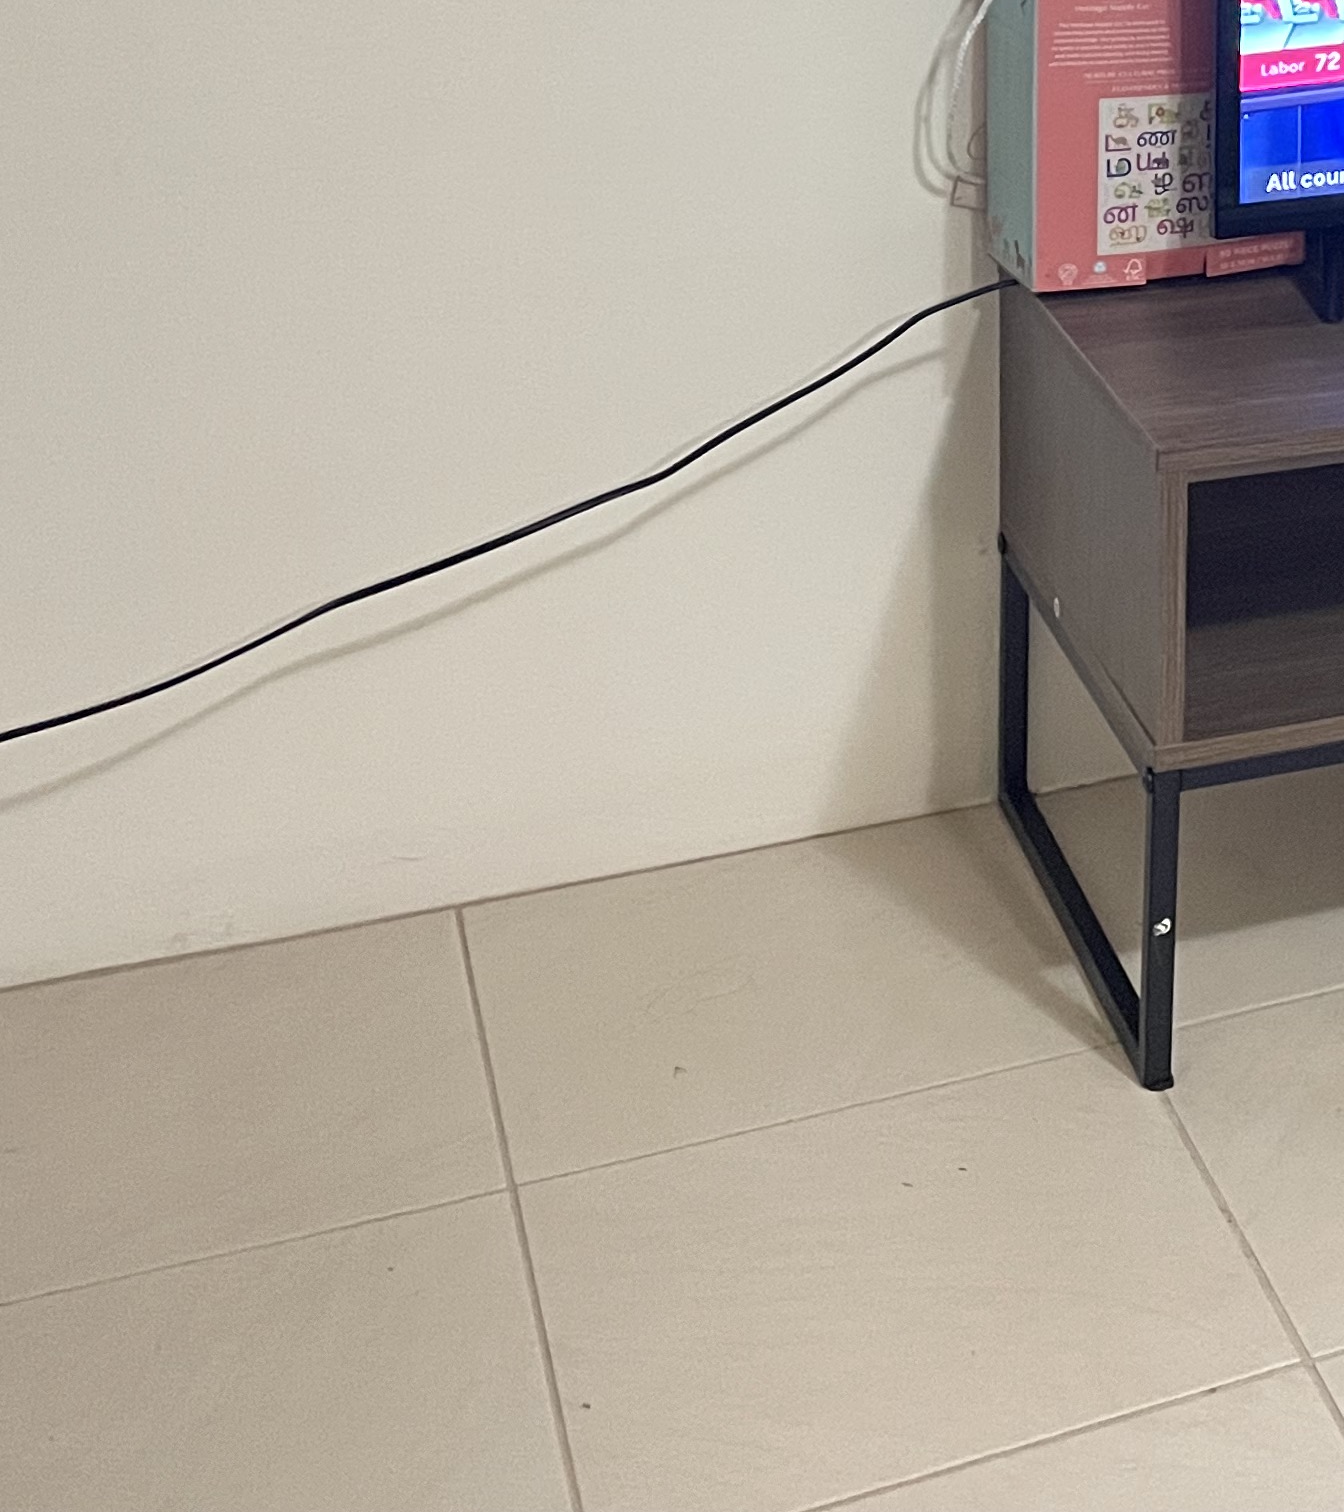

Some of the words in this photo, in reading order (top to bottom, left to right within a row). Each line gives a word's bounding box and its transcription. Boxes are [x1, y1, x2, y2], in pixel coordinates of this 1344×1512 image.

[1260, 61, 1305, 77] Labor
[1314, 51, 1341, 73] 72
[1266, 170, 1297, 193] All
